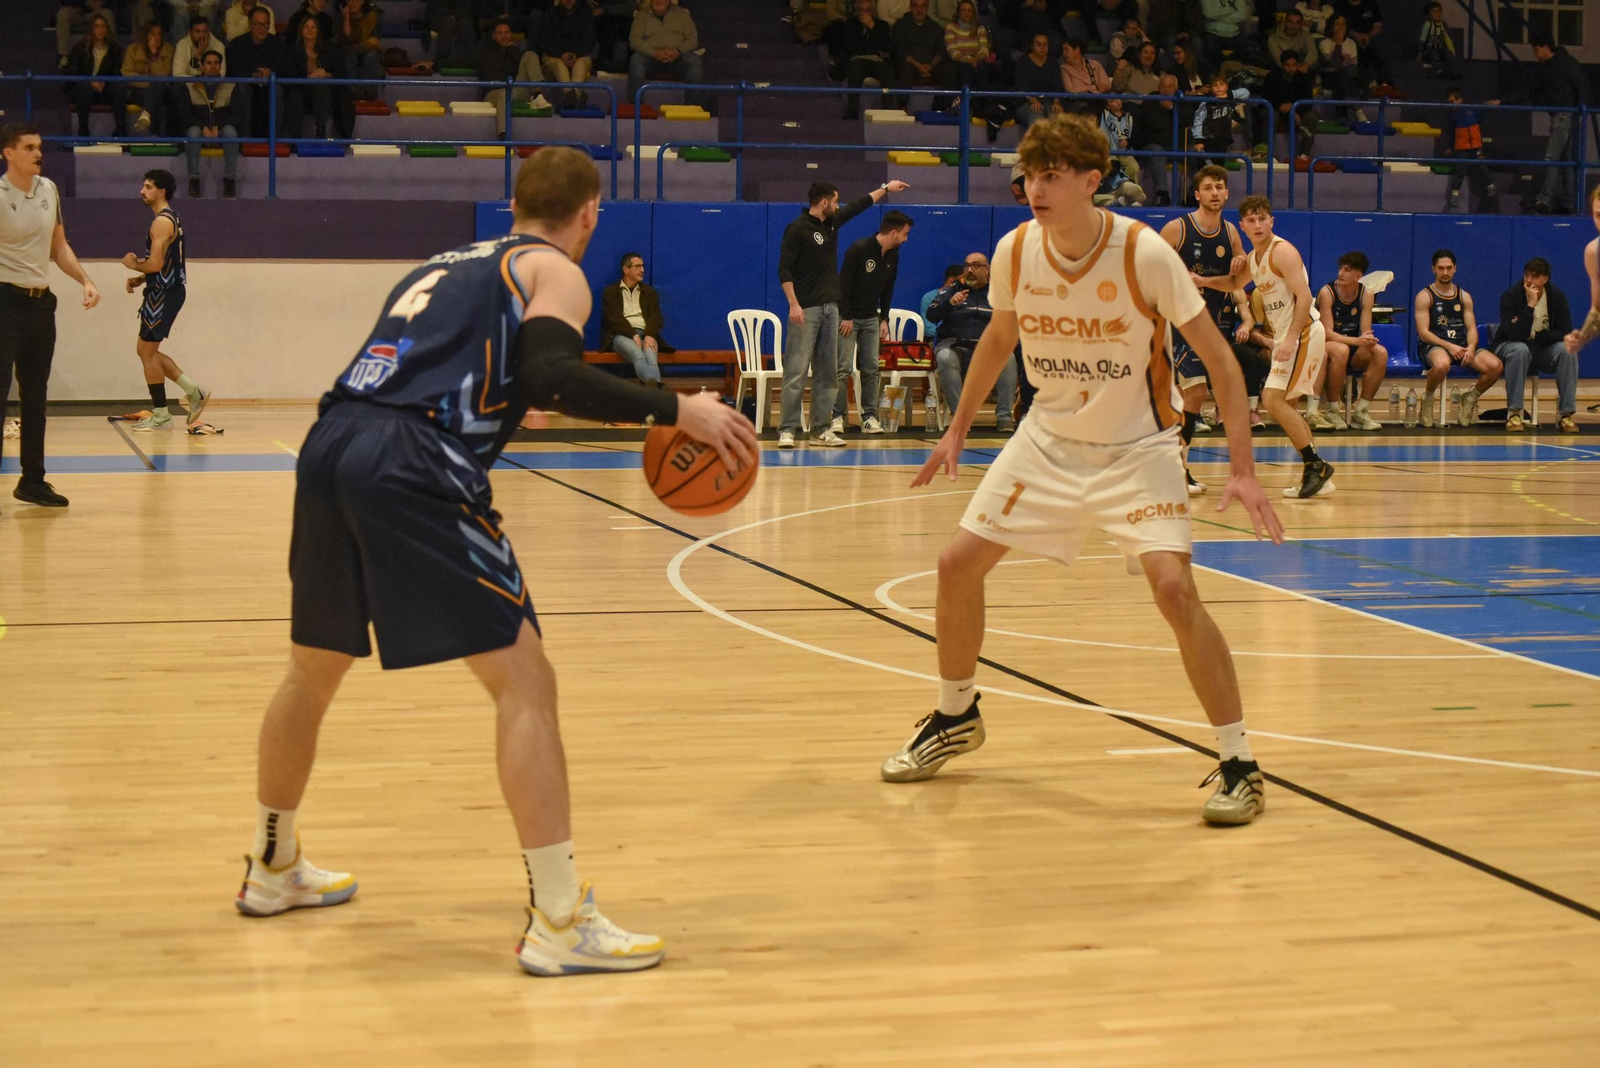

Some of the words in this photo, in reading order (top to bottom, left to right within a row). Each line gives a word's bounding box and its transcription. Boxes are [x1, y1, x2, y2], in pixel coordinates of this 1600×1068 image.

[388, 268, 449, 323] 4
[1018, 314, 1102, 339] CBCM
[1446, 329, 1457, 339] 12
[1027, 354, 1092, 375] MOLINA
[1096, 359, 1132, 379] OLEA
[1001, 482, 1025, 517] 1
[1126, 502, 1174, 525] CBCM
